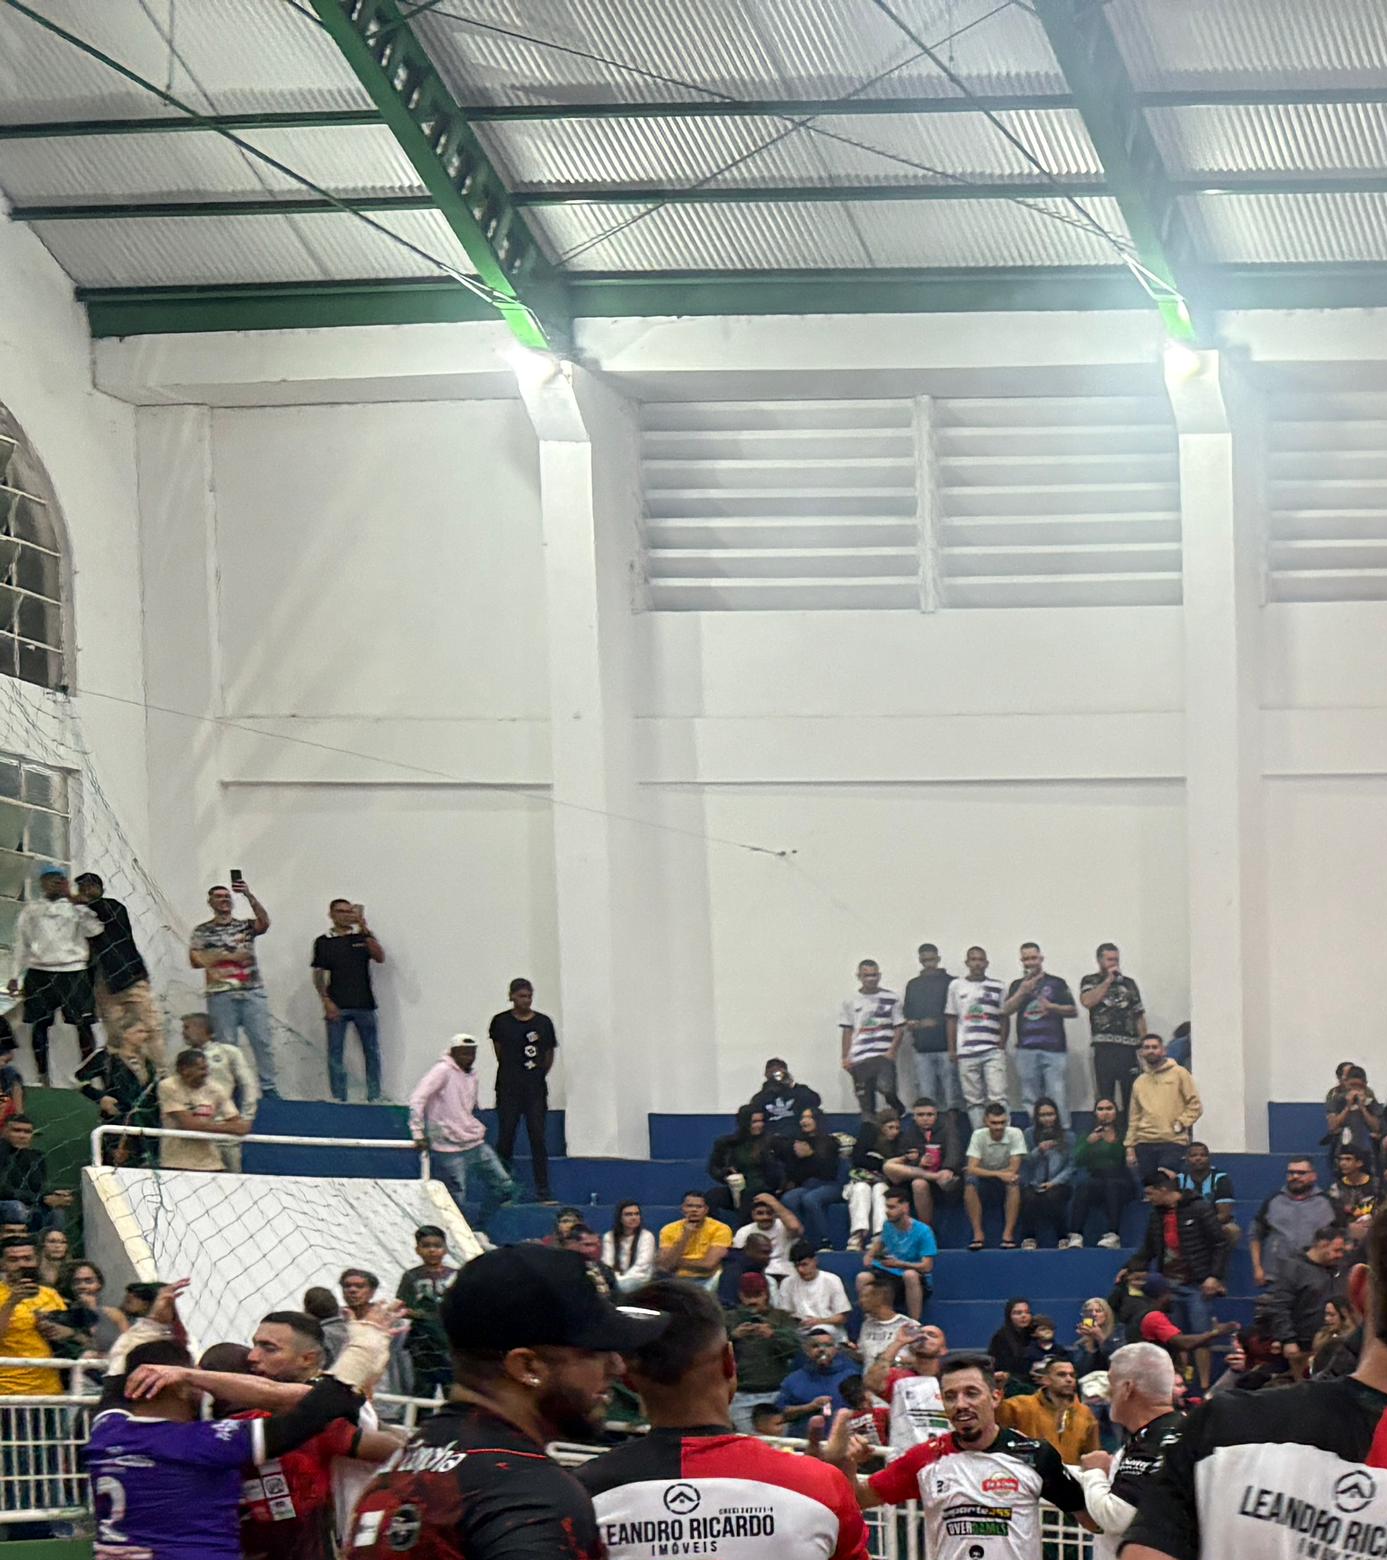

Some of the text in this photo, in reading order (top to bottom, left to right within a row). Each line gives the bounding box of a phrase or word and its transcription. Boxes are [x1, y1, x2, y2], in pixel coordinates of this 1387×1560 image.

[606, 1514, 774, 1547] EANDRO RICARDO
[1239, 1485, 1341, 1545] LEANDRO
[651, 1540, 718, 1557] IMÓVEIS
